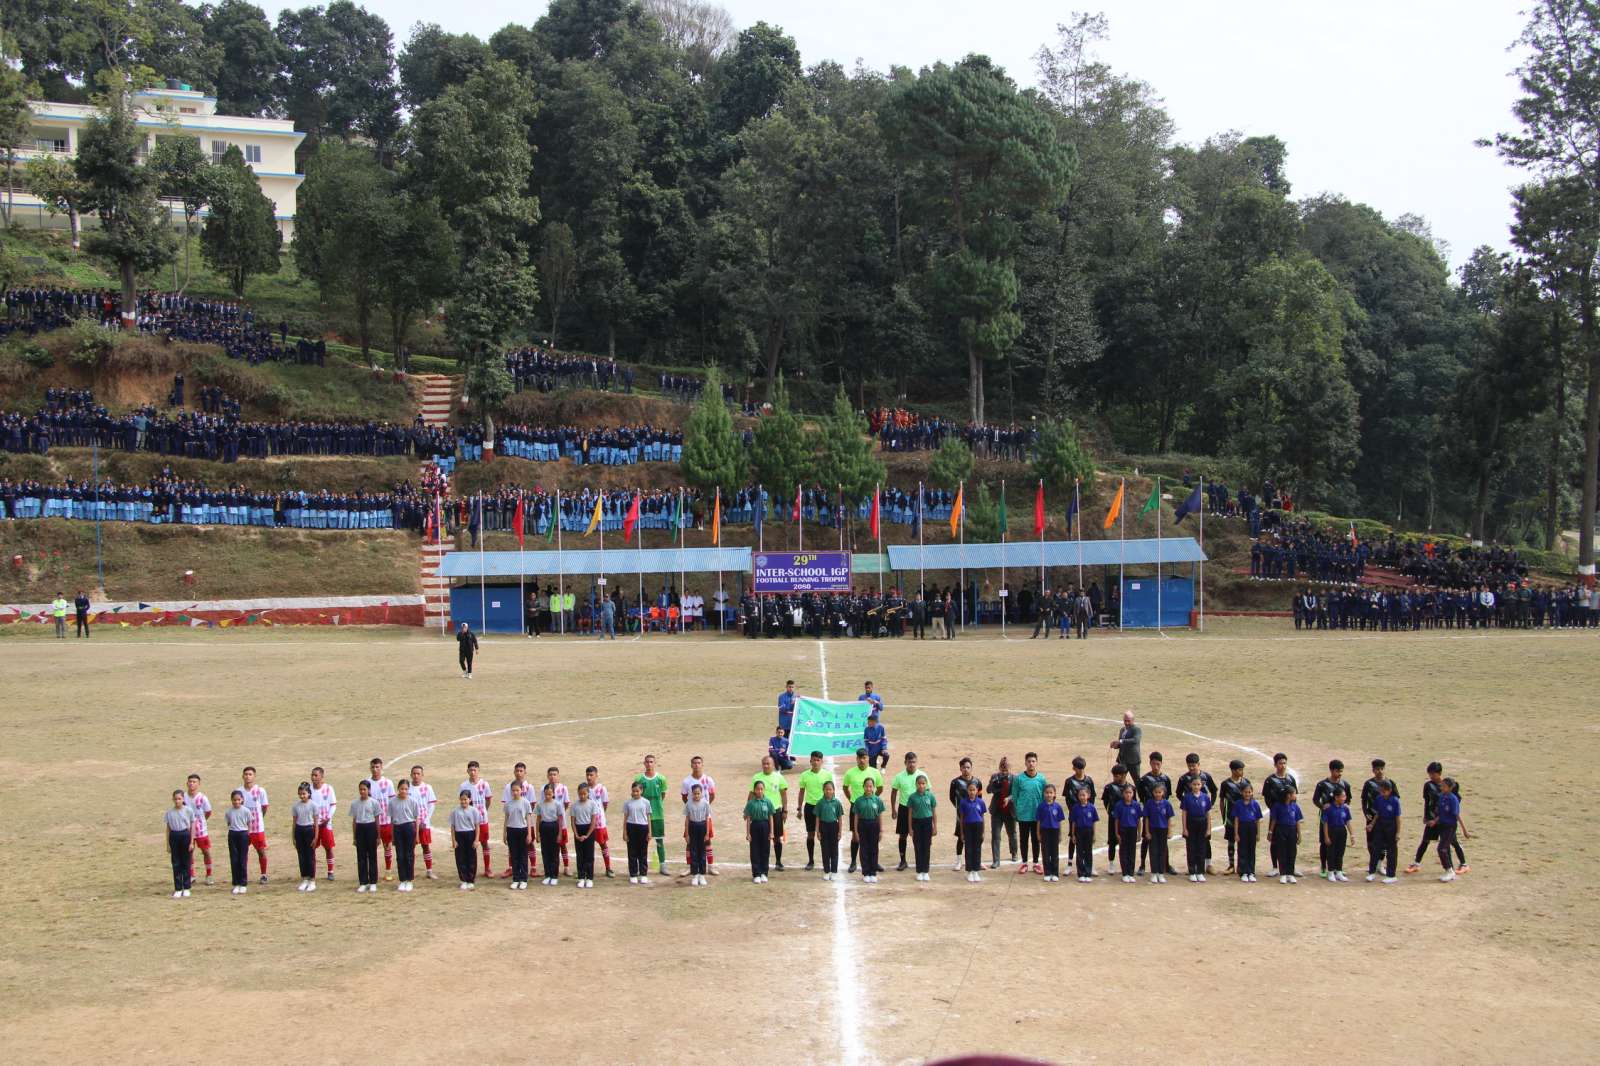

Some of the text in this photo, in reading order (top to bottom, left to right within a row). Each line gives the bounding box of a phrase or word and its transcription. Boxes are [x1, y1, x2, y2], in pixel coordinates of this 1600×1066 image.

[793, 554, 817, 566] 29TH
[756, 567, 849, 577] INTER-SCHOOL IGP
[832, 738, 863, 749] FIFA
